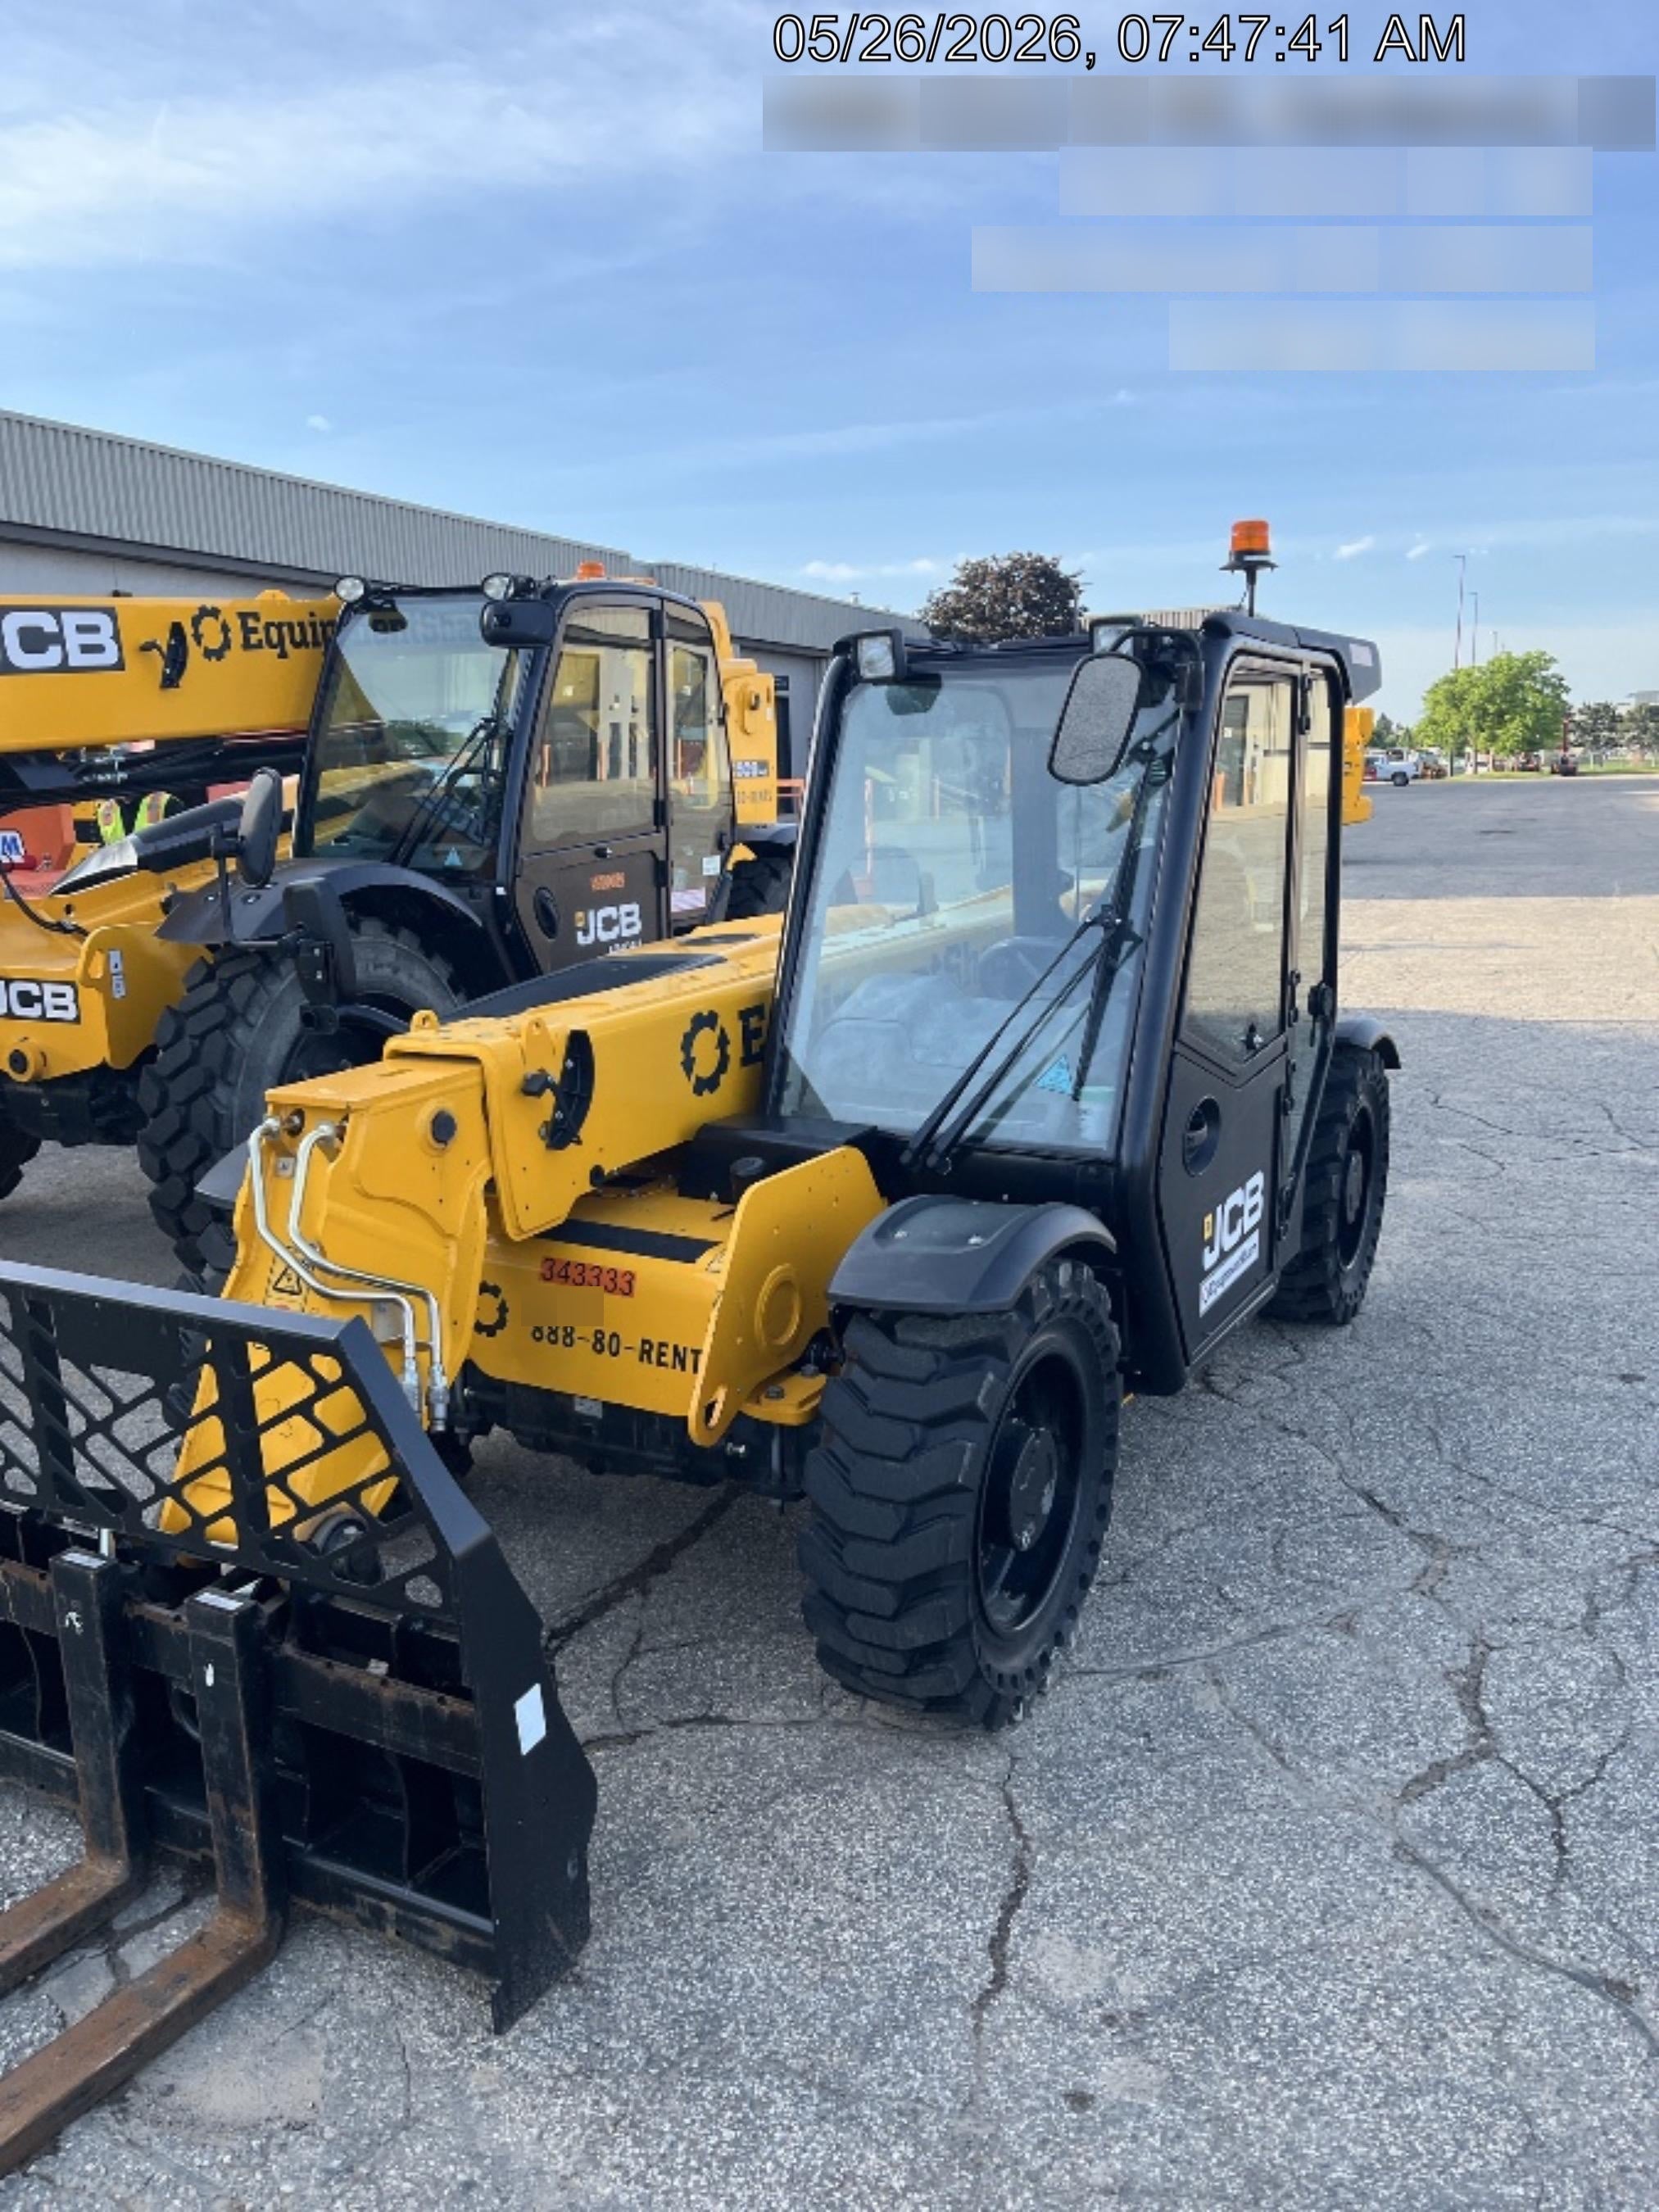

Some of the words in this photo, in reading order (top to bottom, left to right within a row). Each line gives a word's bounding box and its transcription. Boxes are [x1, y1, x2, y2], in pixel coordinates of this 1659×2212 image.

[0, 611, 119, 669] CB
[576, 903, 642, 945] JCB
[1203, 1170, 1264, 1271] JCB
[542, 1258, 636, 1296] 343333
